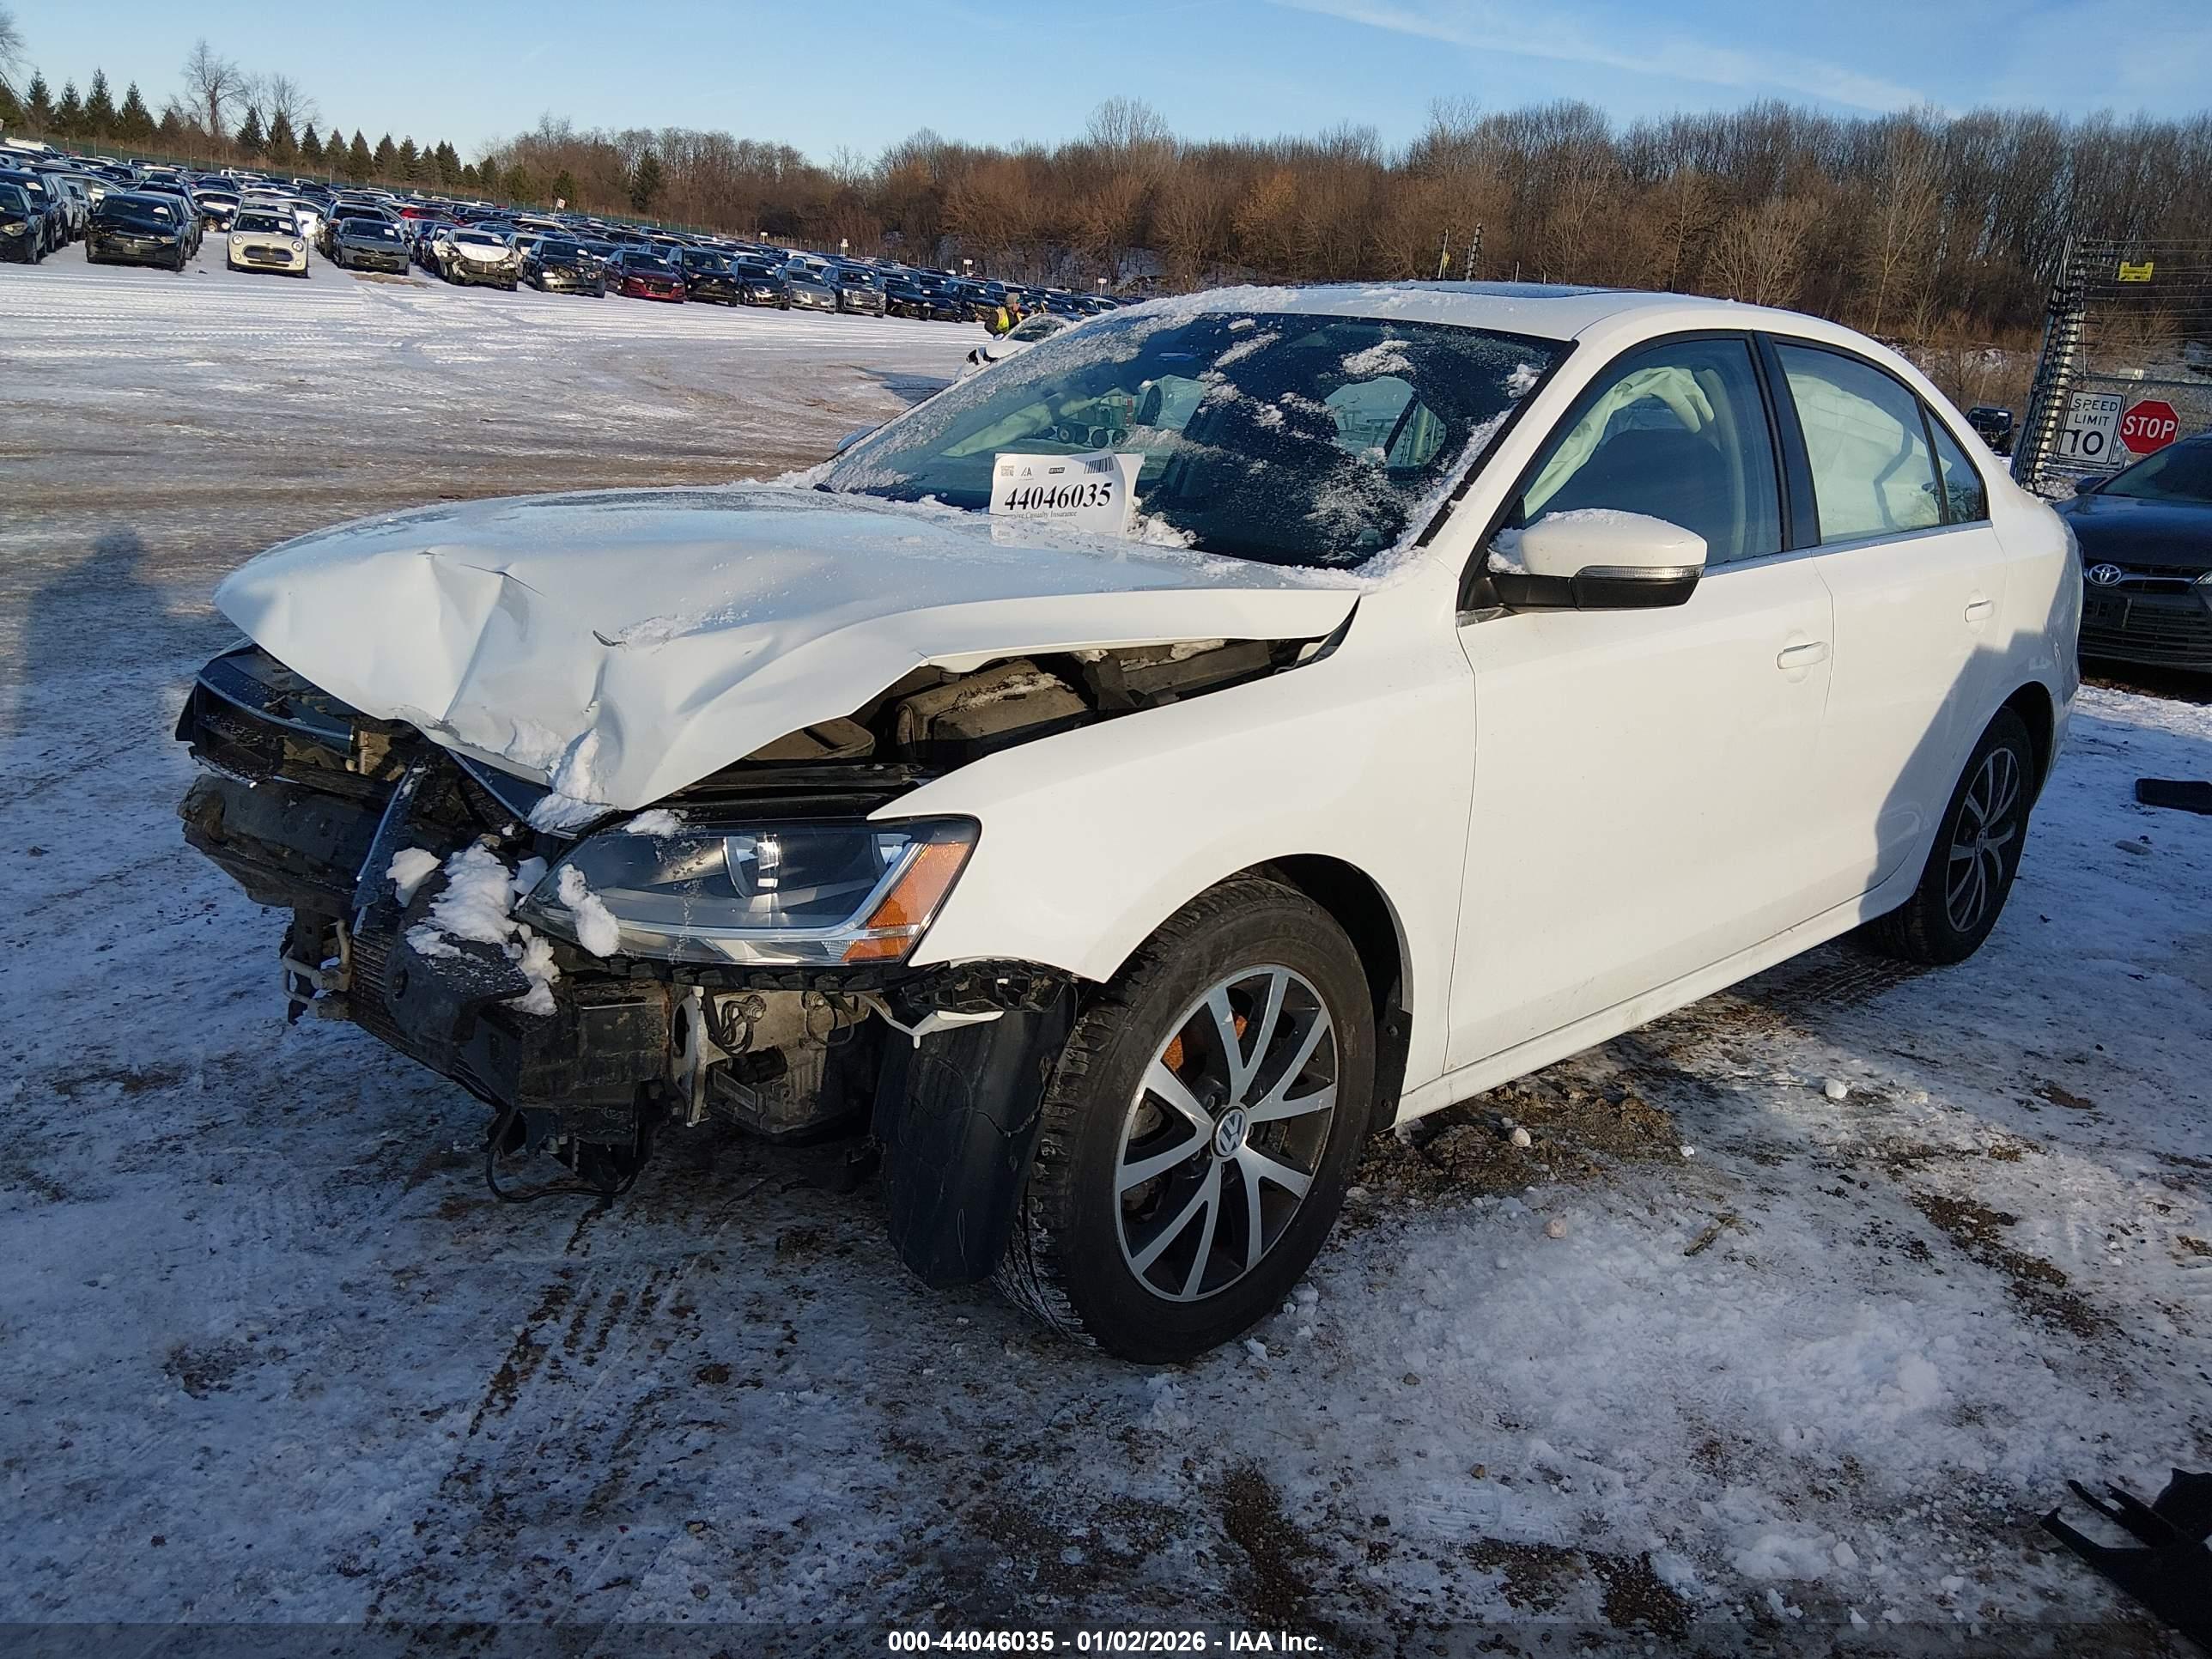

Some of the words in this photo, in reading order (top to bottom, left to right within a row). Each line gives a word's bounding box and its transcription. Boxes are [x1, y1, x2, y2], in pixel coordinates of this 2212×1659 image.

[2074, 398, 2118, 412] SPEED
[2075, 415, 2110, 427] LIMIT
[2123, 415, 2175, 440] STOP
[2065, 430, 2104, 455] 10
[1005, 482, 1113, 510] 44046035
